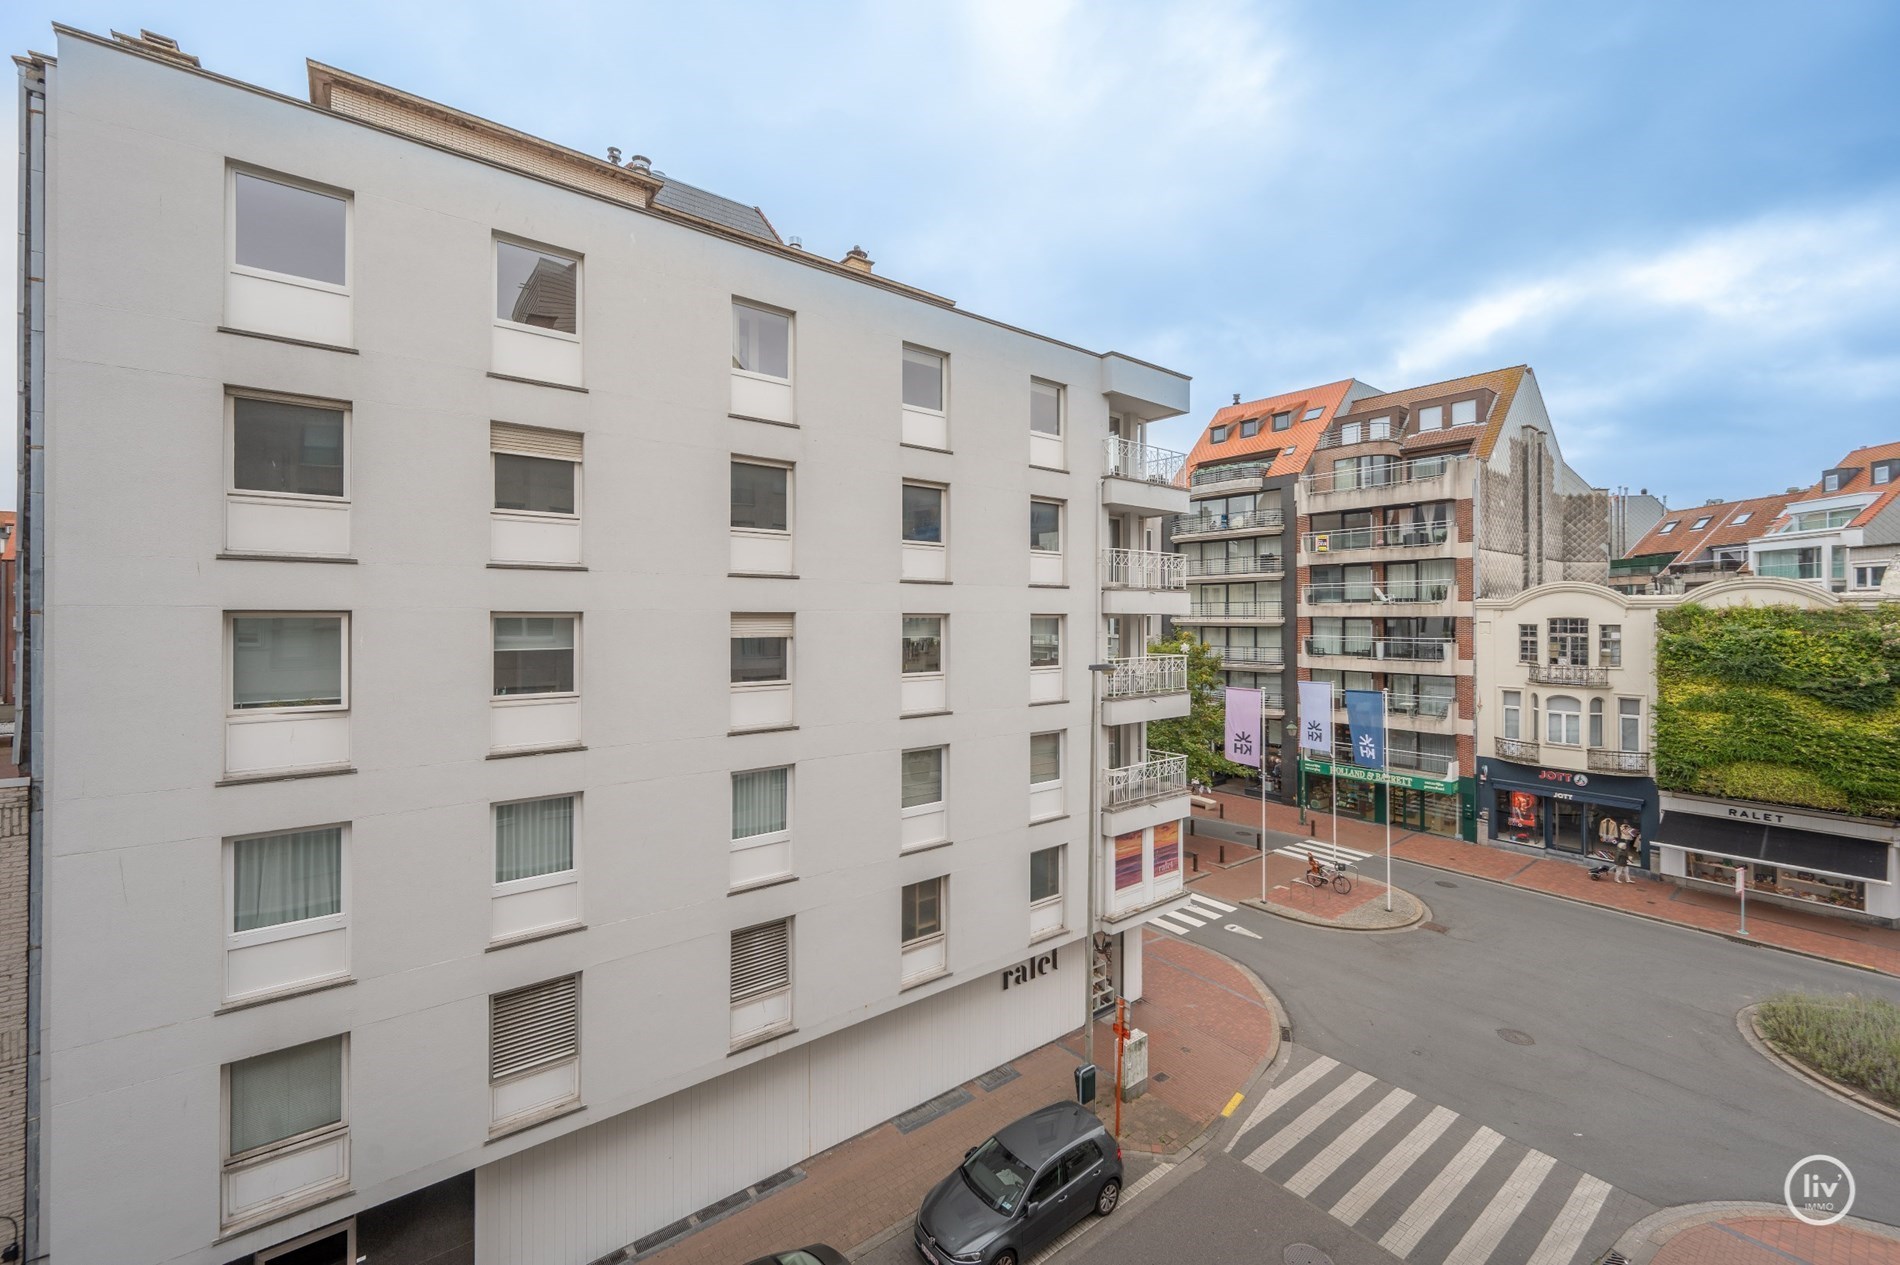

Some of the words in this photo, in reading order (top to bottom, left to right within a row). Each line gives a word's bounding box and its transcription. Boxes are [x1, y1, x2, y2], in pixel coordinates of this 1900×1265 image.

[1329, 765, 1366, 778] HOLLAND
[1367, 771, 1374, 780] &
[1538, 770, 1572, 783] JOTT
[1553, 792, 1573, 800] JOTT
[1728, 808, 1784, 823] RALET
